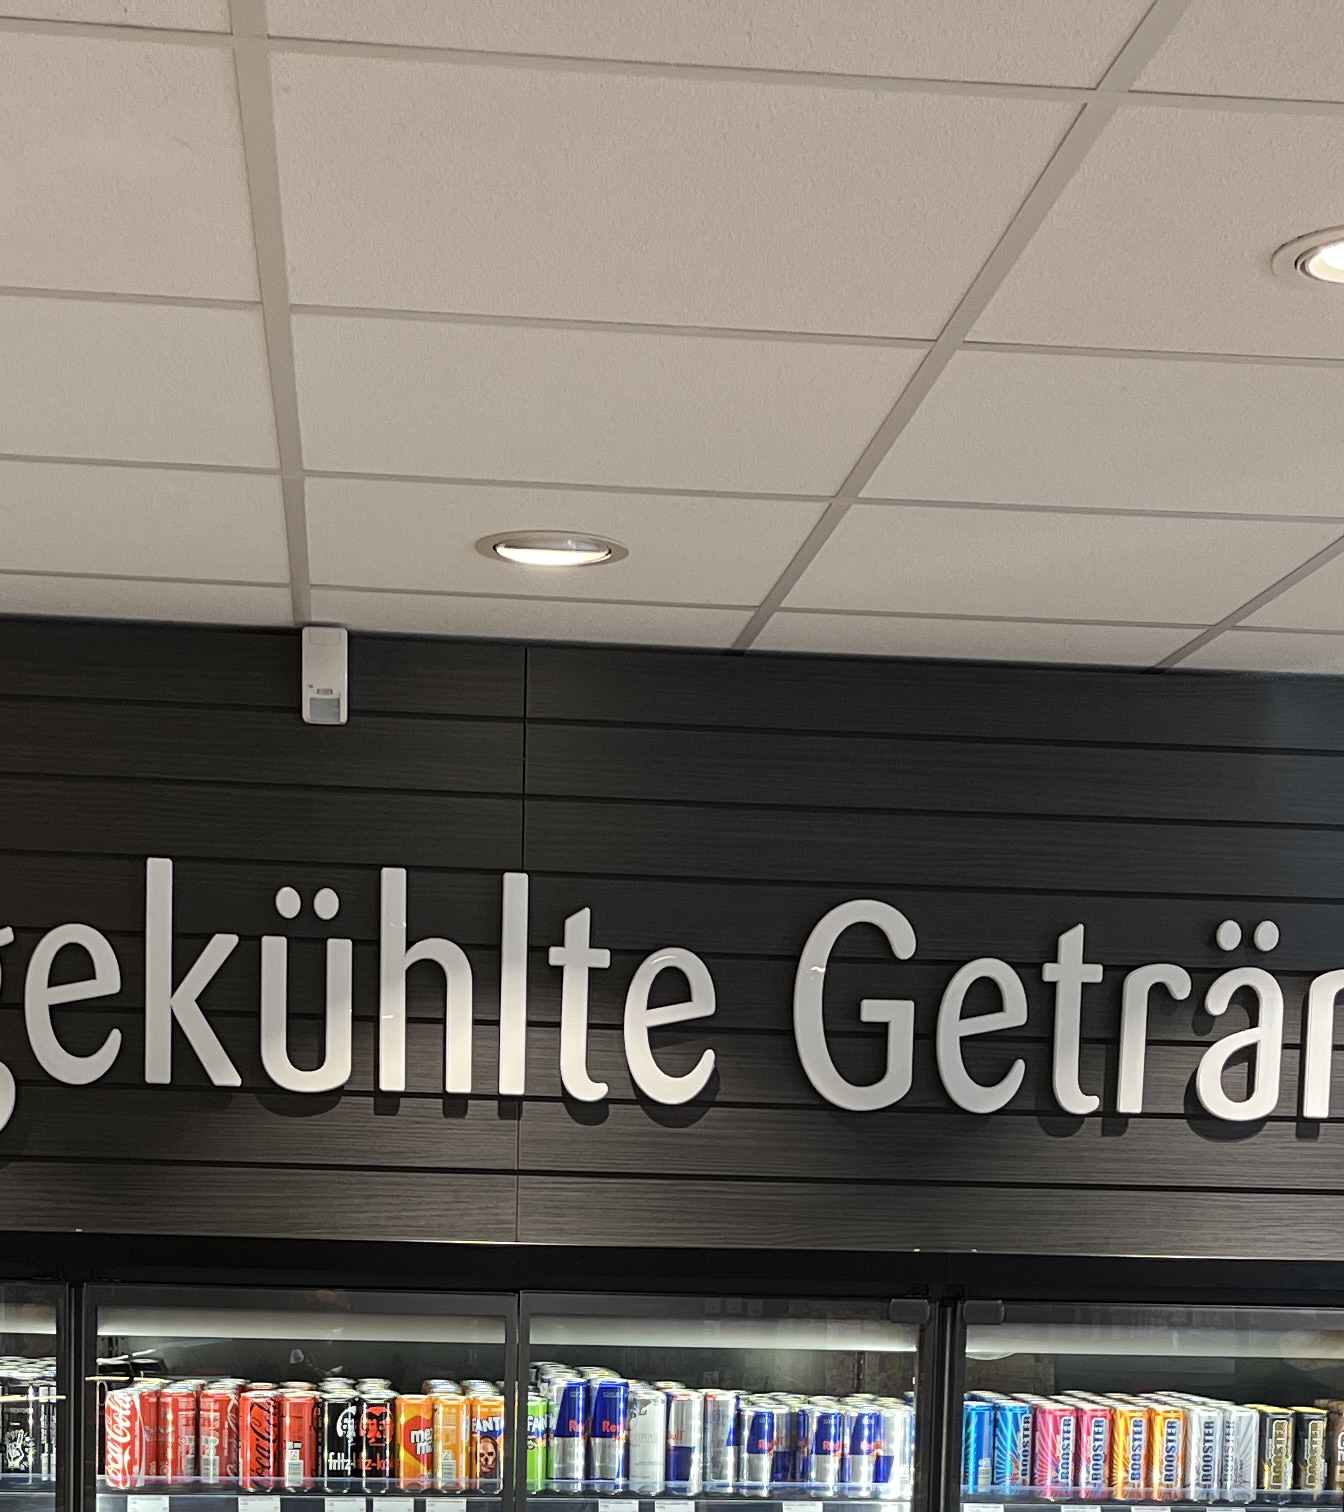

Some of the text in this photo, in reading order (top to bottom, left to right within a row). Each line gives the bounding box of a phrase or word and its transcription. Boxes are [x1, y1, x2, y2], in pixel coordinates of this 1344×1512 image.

[1020, 1414, 1032, 1479] BOOSTER
[1060, 1417, 1072, 1482] BOOSTER
[1090, 1418, 1104, 1483] BOOSTER
[1129, 1418, 1143, 1483] BOOSTER
[1163, 1418, 1178, 1483] BOOSTER
[1201, 1420, 1215, 1484] BOOSTER
